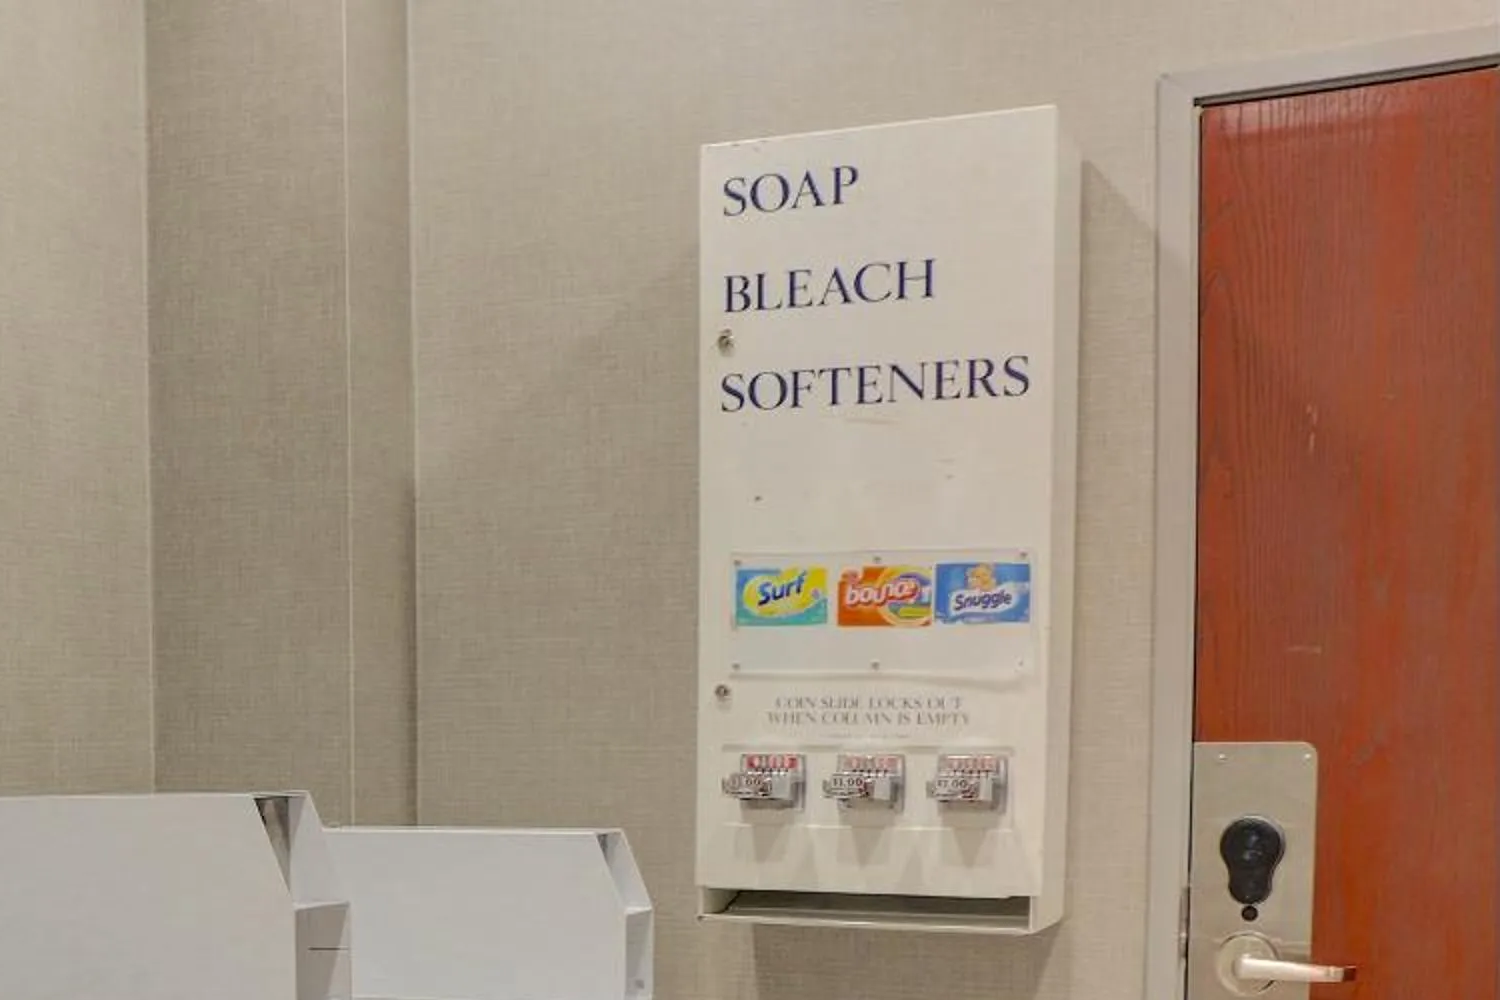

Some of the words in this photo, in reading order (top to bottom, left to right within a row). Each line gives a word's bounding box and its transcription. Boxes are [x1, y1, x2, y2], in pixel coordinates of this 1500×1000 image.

[723, 165, 859, 217] SOAP
[724, 258, 936, 313] BLEACH
[721, 355, 1029, 413] SOFTENERS
[758, 570, 808, 606] Surf
[954, 588, 1013, 612] Snuggle
[767, 711, 817, 725] WHEN
[898, 711, 912, 725] IS
